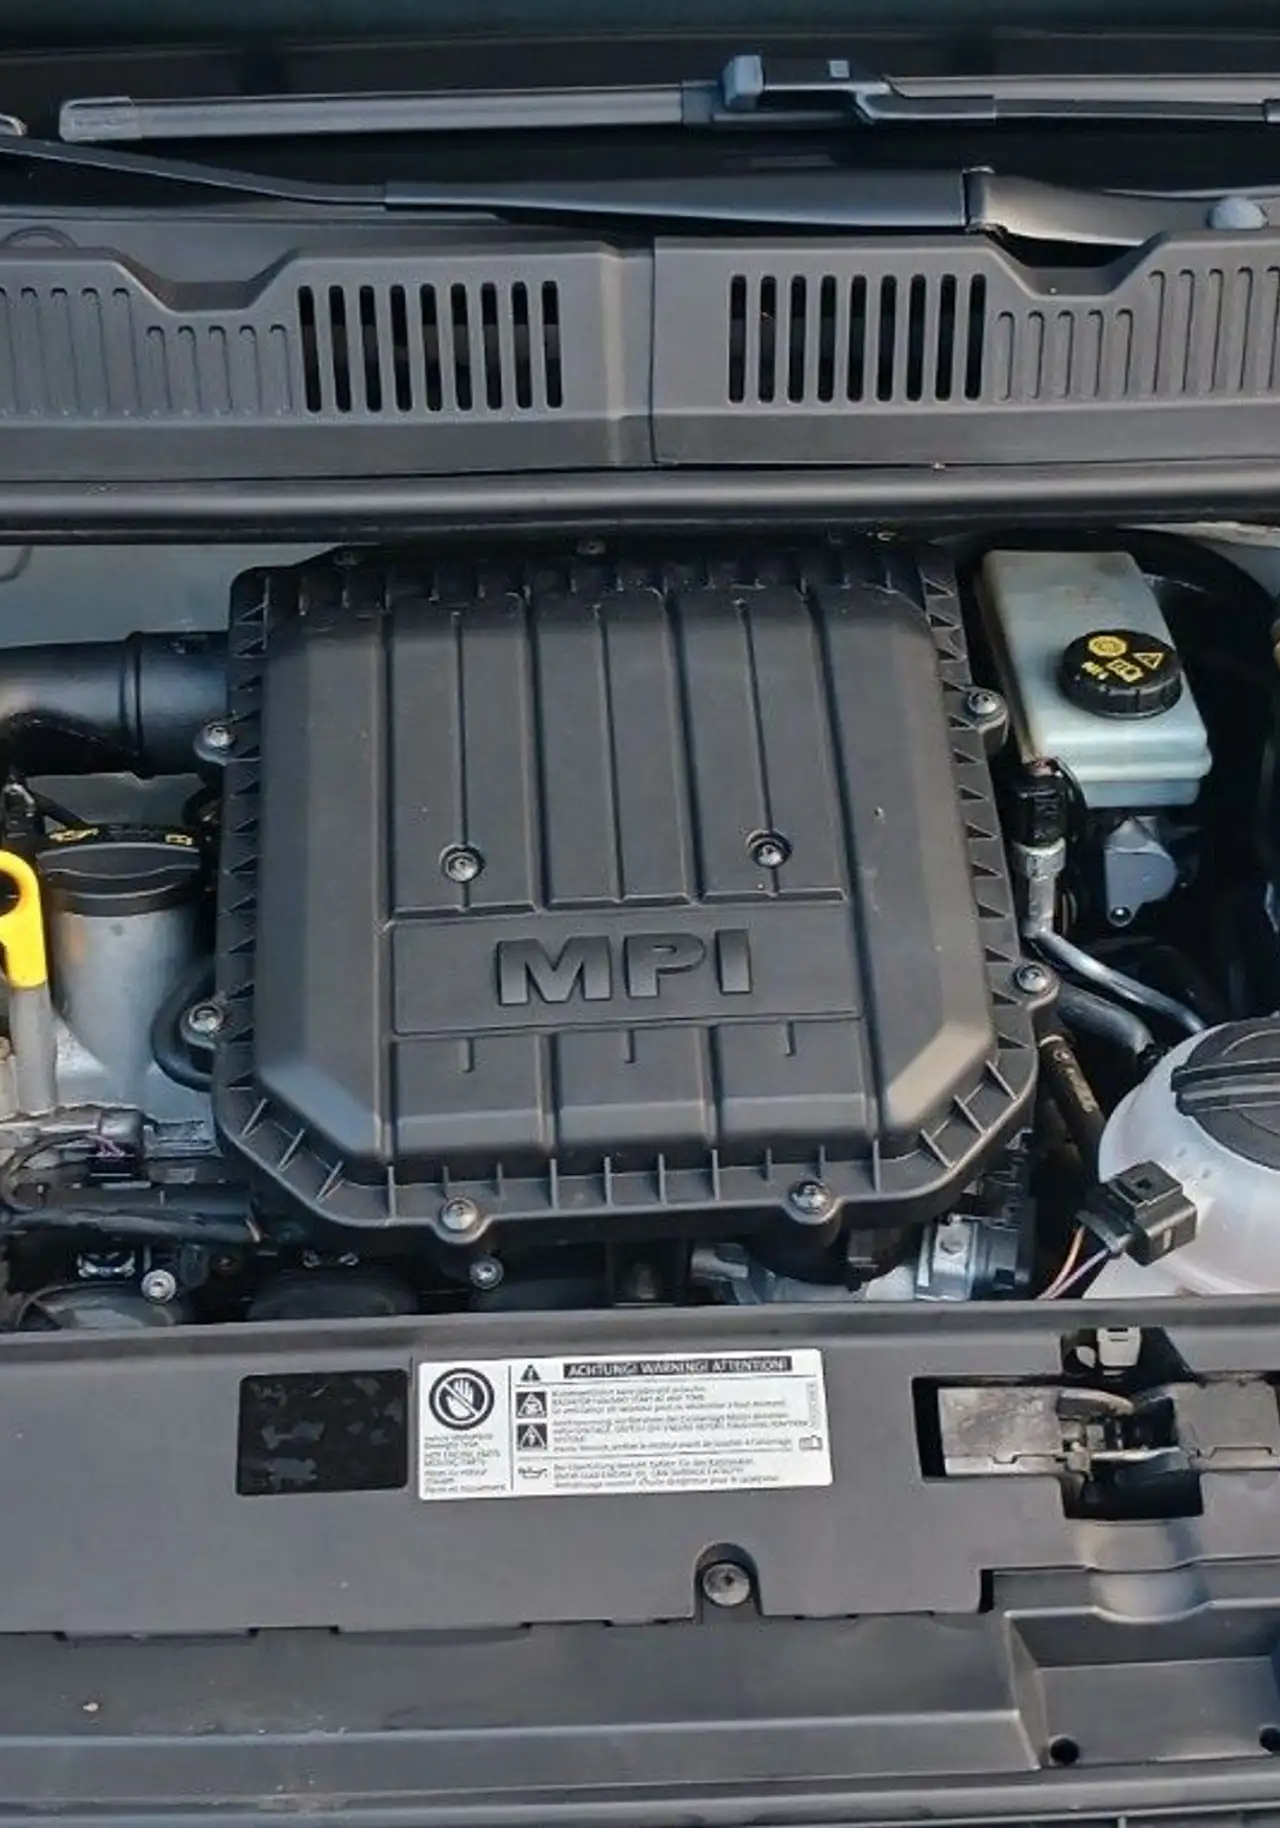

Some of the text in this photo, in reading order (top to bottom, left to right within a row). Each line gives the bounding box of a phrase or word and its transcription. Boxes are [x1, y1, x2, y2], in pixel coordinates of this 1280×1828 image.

[495, 928, 752, 1006] MPI
[567, 1363, 639, 1378] ACHTUNG!
[641, 1360, 708, 1375] WARNING!
